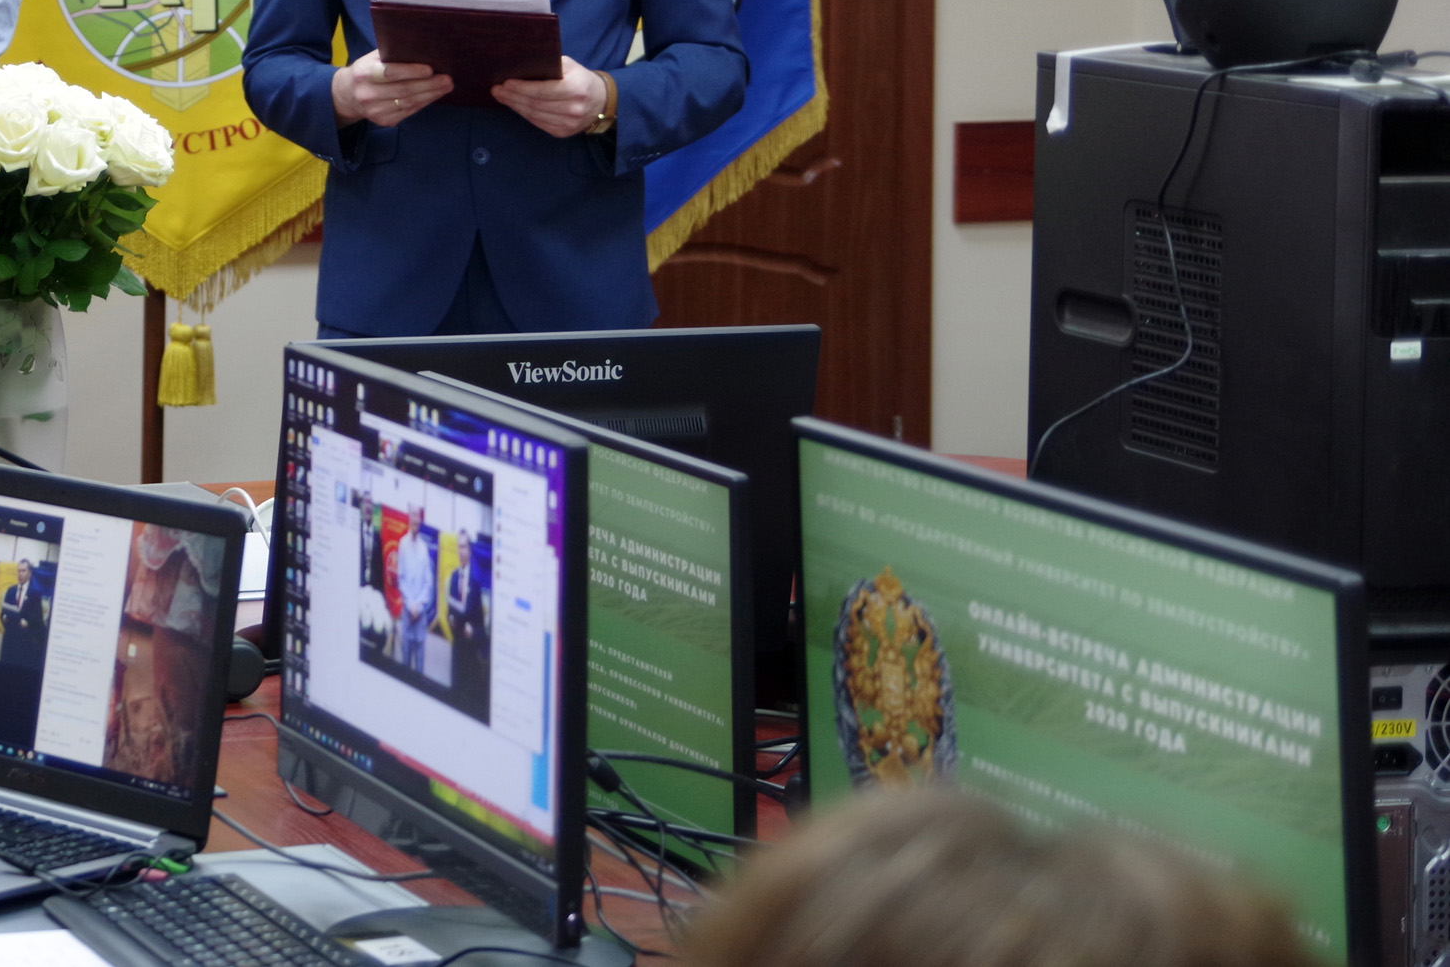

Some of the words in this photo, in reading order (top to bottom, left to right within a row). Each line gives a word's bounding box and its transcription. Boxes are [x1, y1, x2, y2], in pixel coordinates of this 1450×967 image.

[170, 117, 271, 155] СТРО
[507, 359, 624, 384] ViewSonic
[590, 567, 614, 587] 2020
[618, 579, 647, 601] ГОДА
[611, 554, 618, 567] С
[621, 558, 716, 606] ВЫПУСКНИКАМИ
[619, 536, 721, 586] АДМИНИСТРАЦИИ
[968, 600, 1130, 672] ОНЛАЙН-ВСТРЕЧА
[1135, 656, 1322, 738] АДМИНИСТРАЦИИ
[977, 632, 1116, 698] УНИВЕРСИТЕТА
[1121, 682, 1134, 704] С
[1139, 690, 1313, 769] ВЫПУСКНИКАМИ
[1084, 699, 1129, 733] 2020
[1134, 717, 1188, 755] ГОДА
[1372, 721, 1413, 738] /230V
